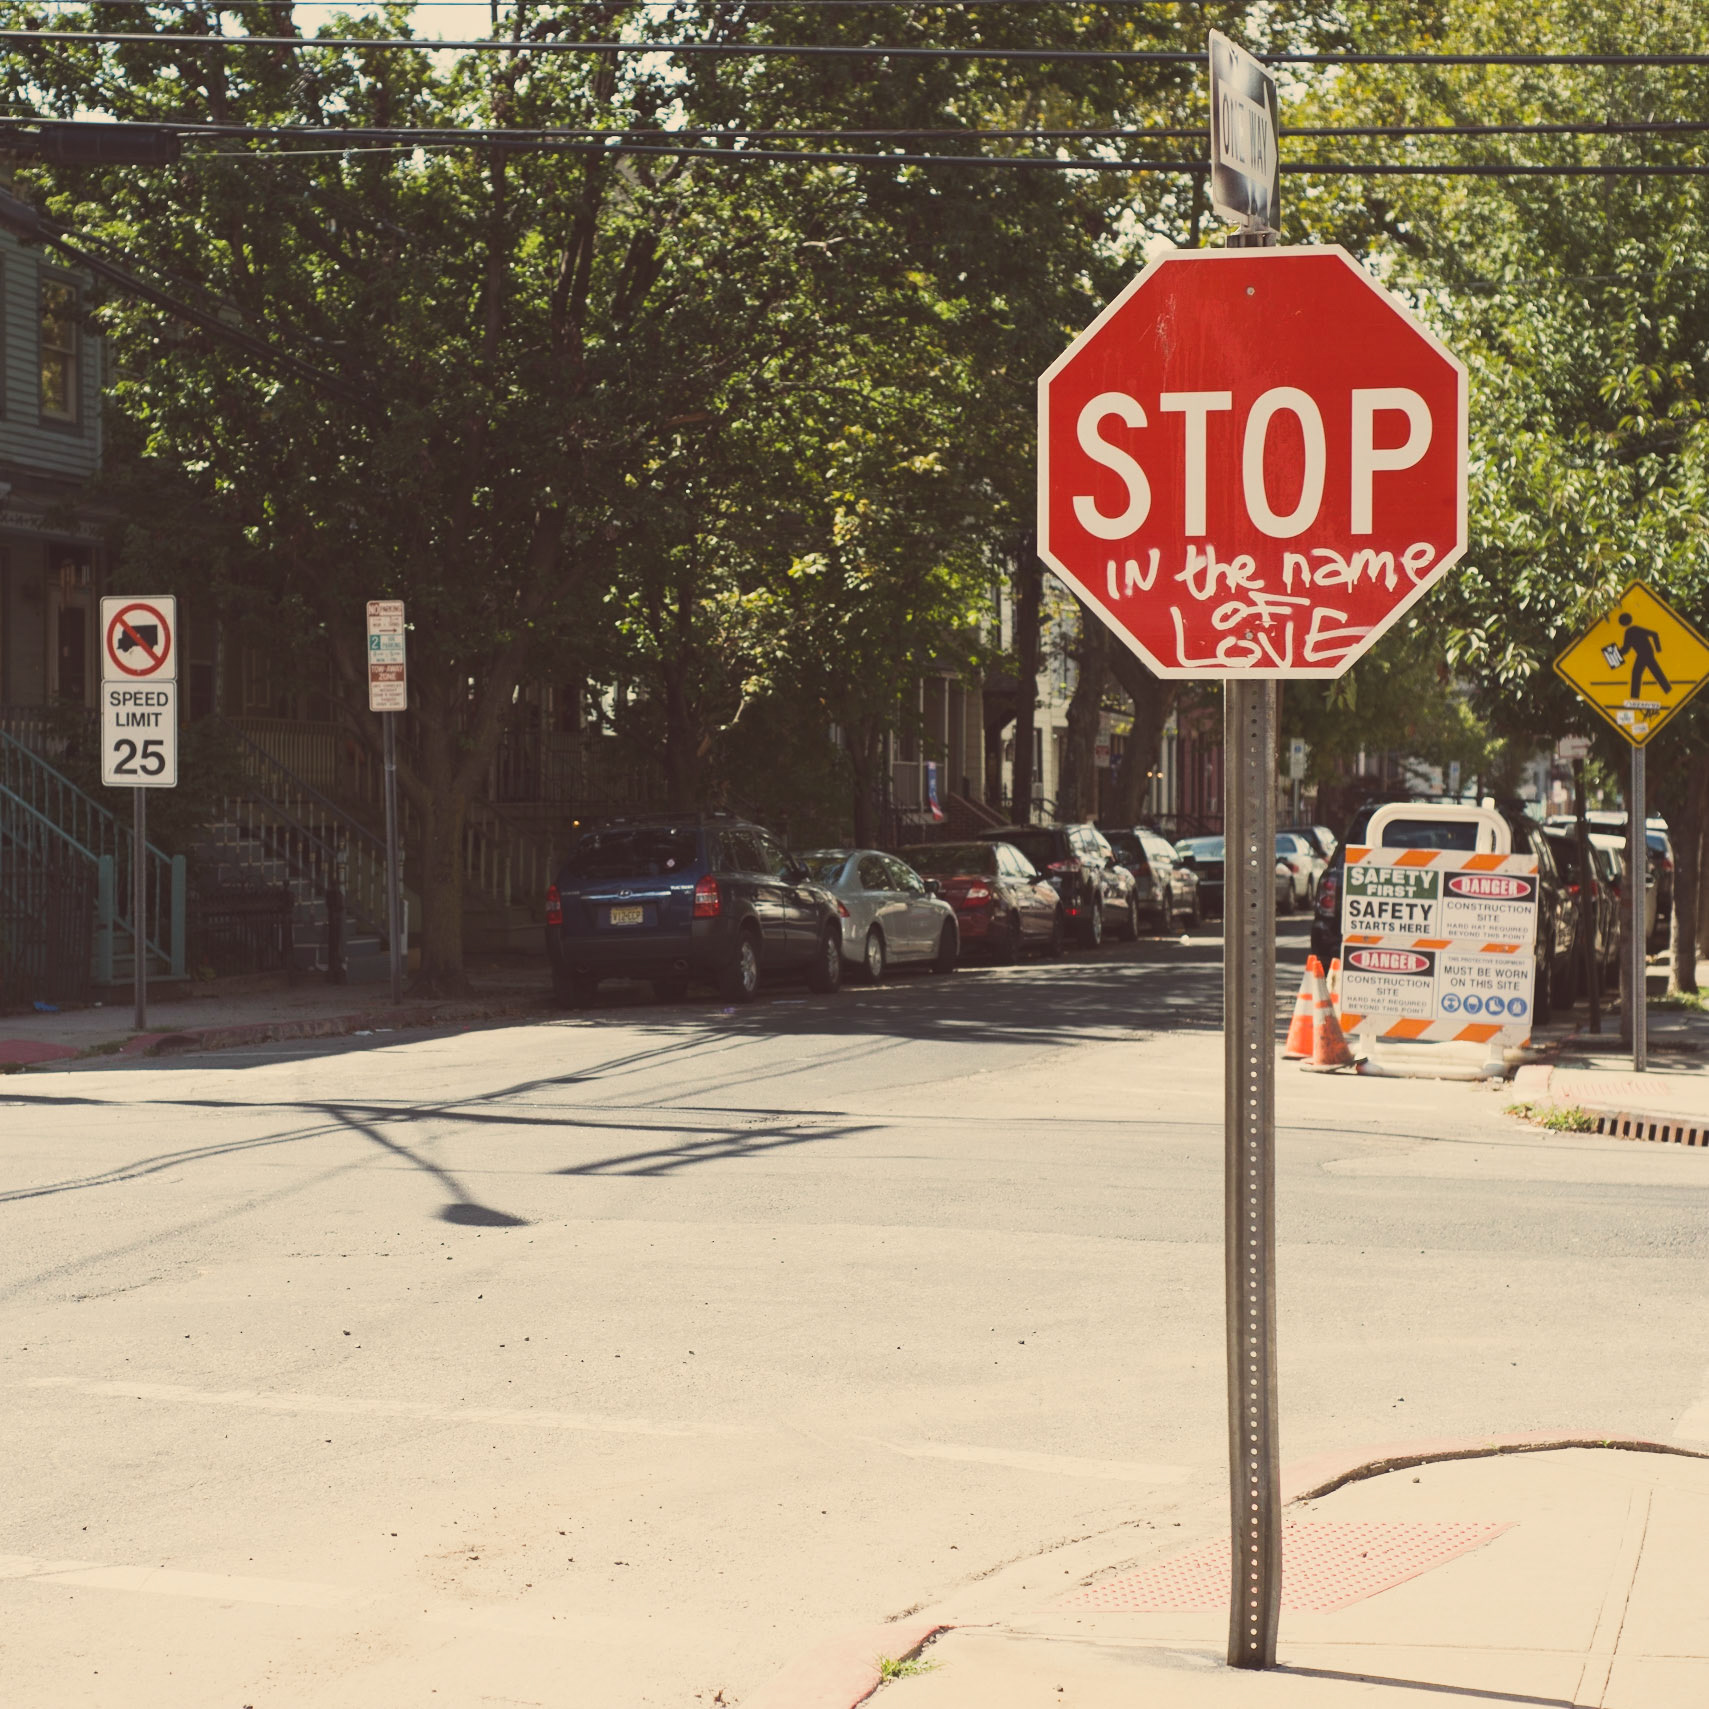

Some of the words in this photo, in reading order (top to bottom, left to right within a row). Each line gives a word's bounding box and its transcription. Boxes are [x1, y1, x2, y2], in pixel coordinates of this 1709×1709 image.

[1222, 92, 1245, 163] ONE
[1249, 108, 1267, 177] WAY
[1072, 386, 1433, 540] STOP
[1107, 548, 1160, 600] IN
[1174, 544, 1264, 600] the
[1282, 541, 1436, 595] name
[371, 636, 379, 649] 2
[109, 691, 169, 707] SPEED
[115, 712, 162, 727] LIMIT
[113, 739, 166, 776] 25
[1350, 867, 1434, 889] SAFETY
[1366, 884, 1417, 898] FIRST
[1461, 878, 1518, 896] DANGER
[1349, 900, 1433, 921] SAFETY
[1447, 901, 1532, 914] CONSTRUCTION
[1477, 914, 1500, 923] SITE
[1350, 920, 1395, 932] STARTS
[1399, 923, 1431, 934] HERE
[1448, 930, 1480, 938] BEYOND
[1361, 951, 1417, 970] DANGER
[1444, 965, 1473, 976] MUST
[1477, 967, 1491, 977] BE
[1495, 968, 1528, 979] WORN
[1347, 975, 1431, 988] CONSTRUCTION
[1450, 977, 1466, 987] ON
[1470, 979, 1493, 989] THIS
[1496, 980, 1521, 991] SITE
[1376, 987, 1399, 997] SITE
[1348, 1003, 1380, 1011] BEYOND
